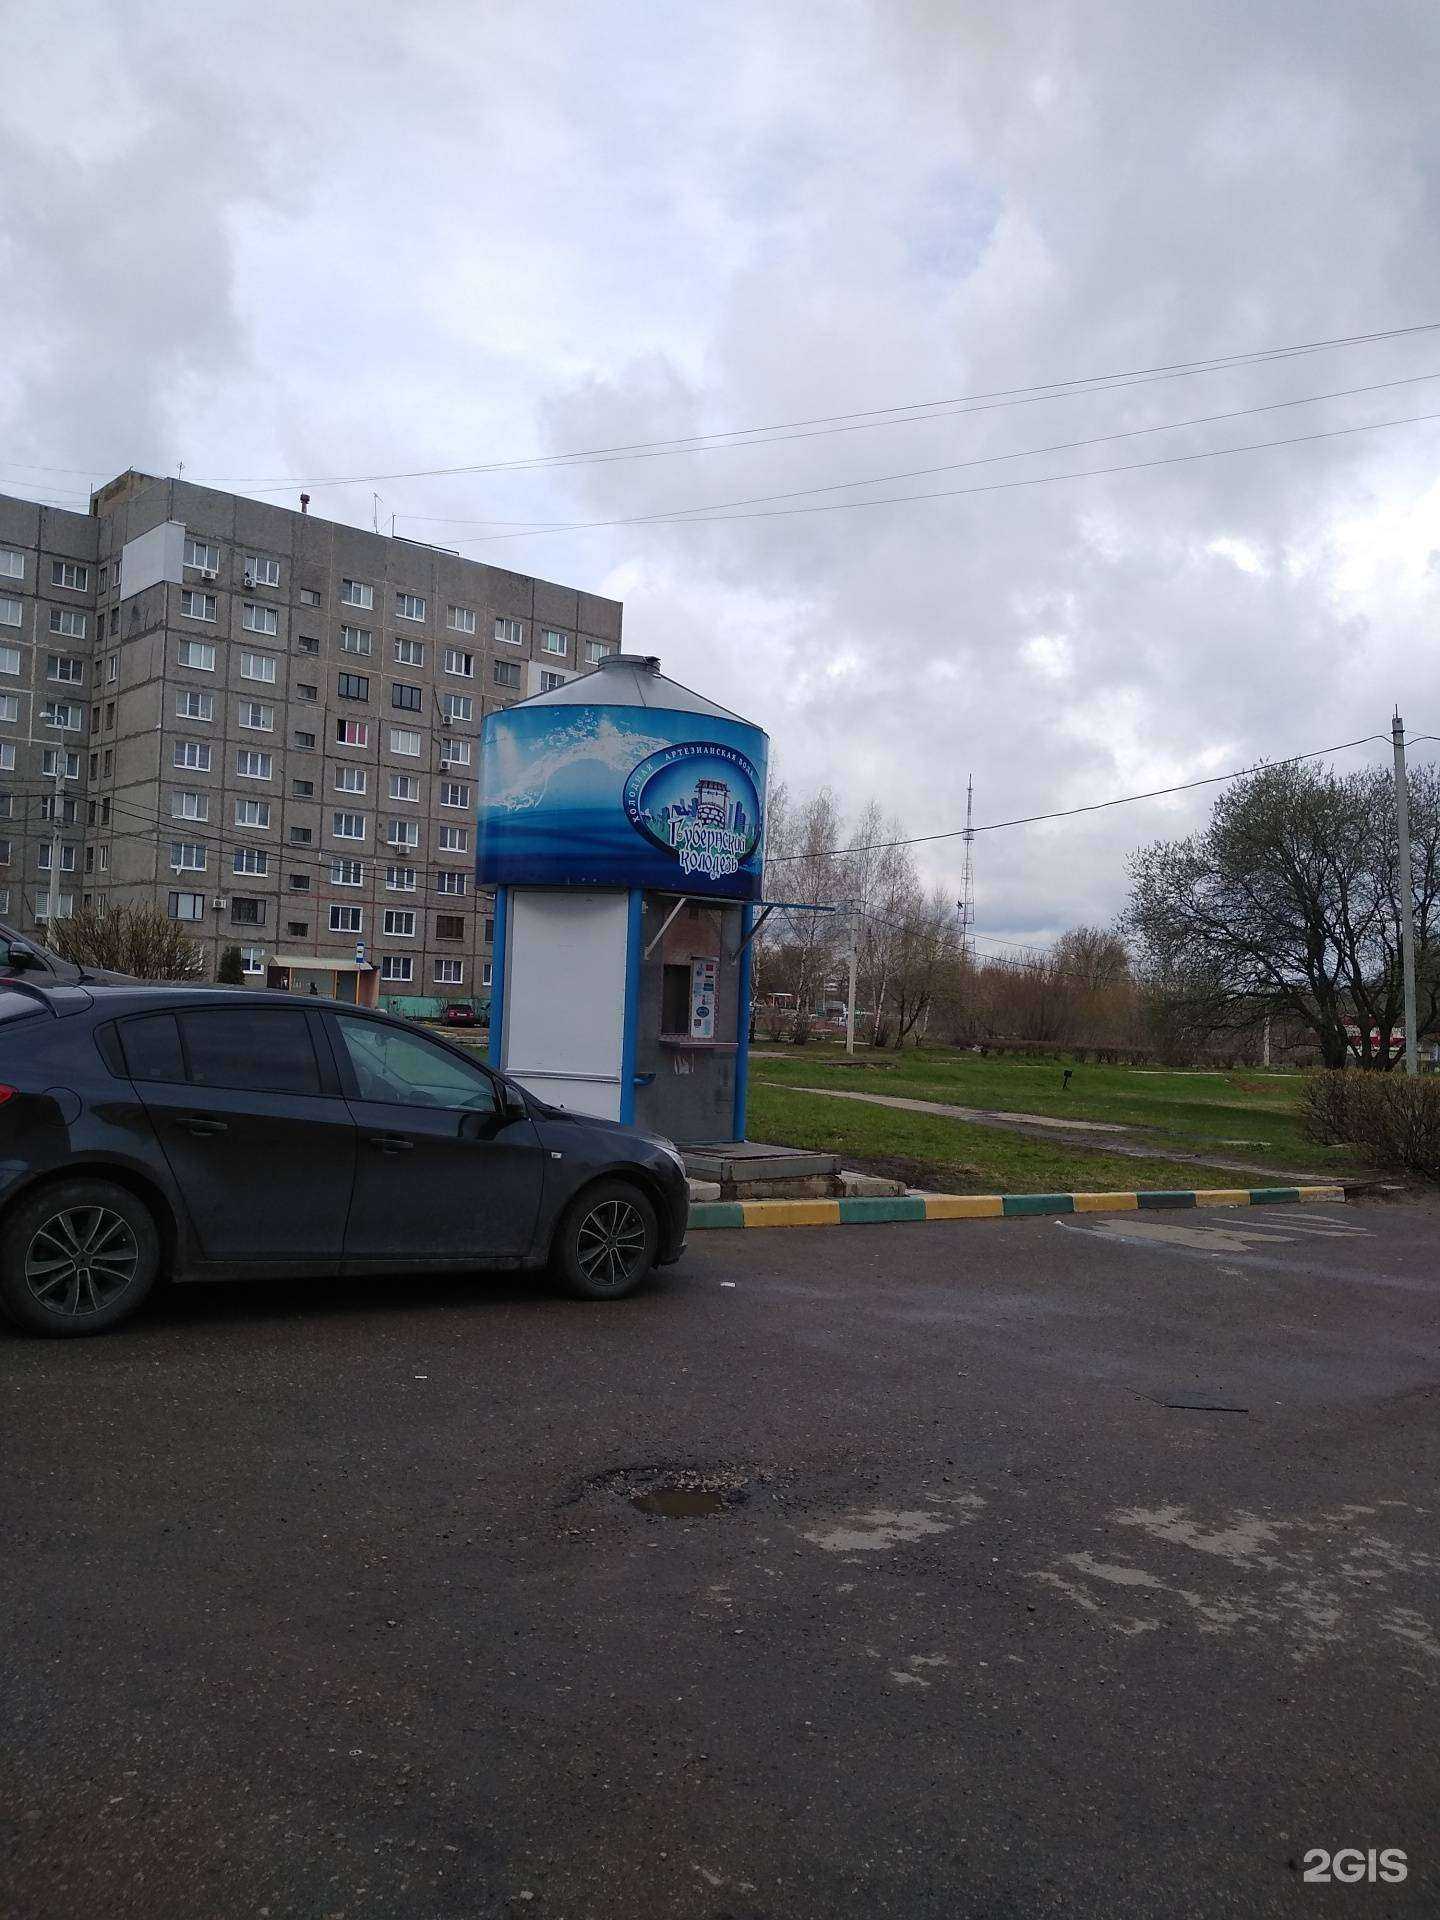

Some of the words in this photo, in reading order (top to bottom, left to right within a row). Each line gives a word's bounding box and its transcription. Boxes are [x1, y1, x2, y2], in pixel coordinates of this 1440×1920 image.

[628, 763, 654, 824] ХОЛОДНАЯ
[664, 746, 737, 761] АРТЕЗИАНСКАЯ
[668, 816, 746, 853] Губернский
